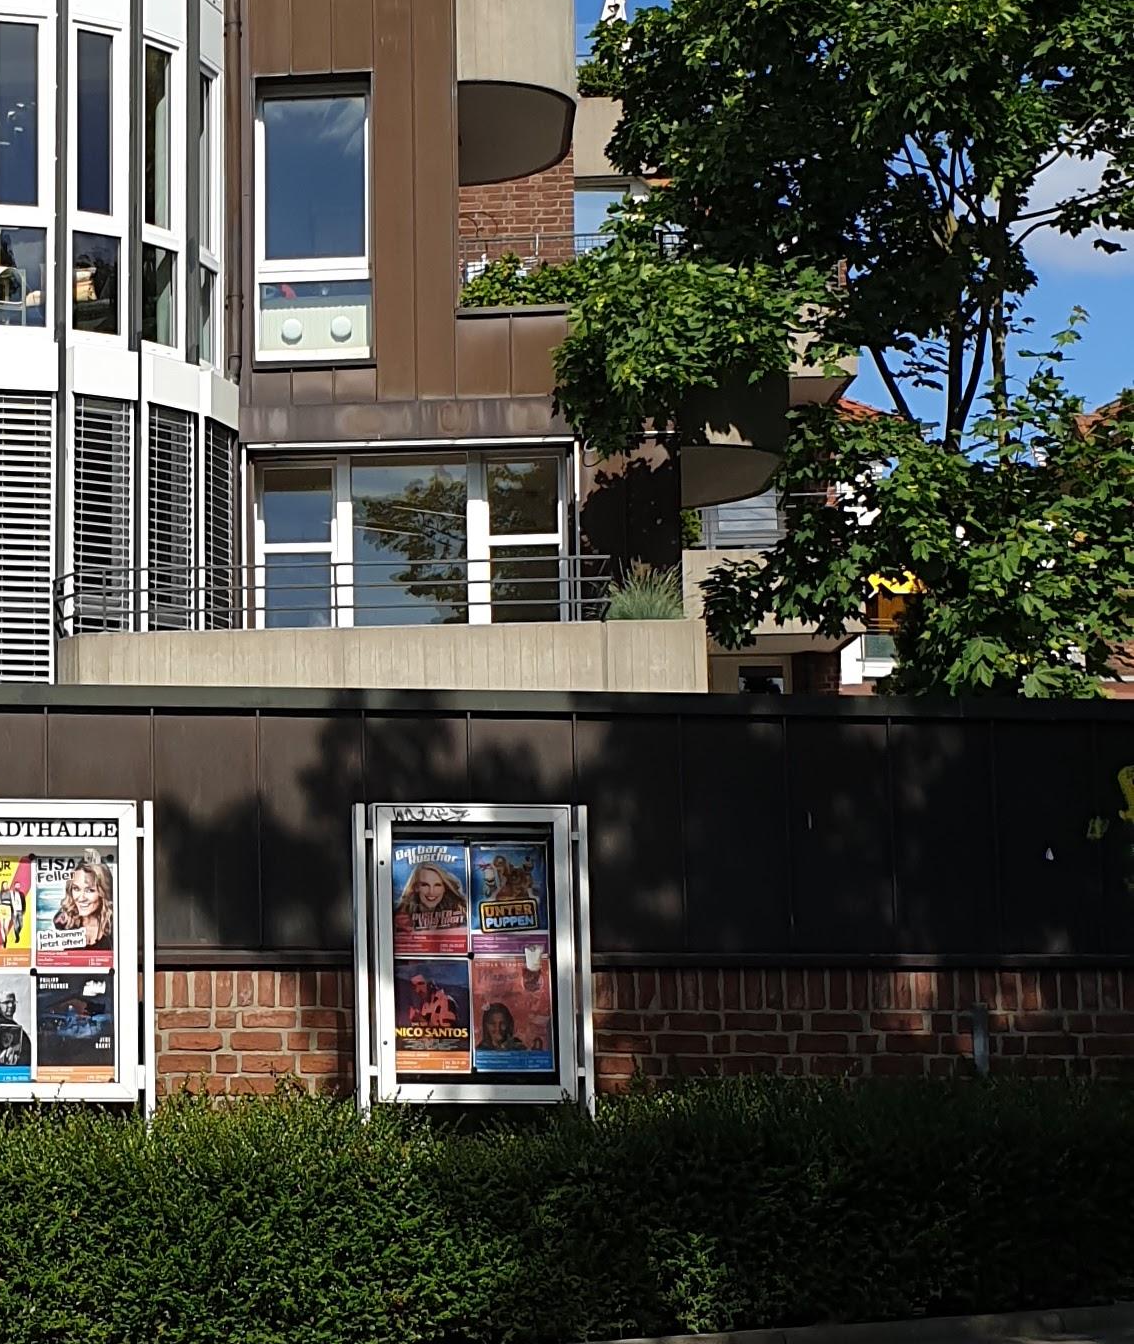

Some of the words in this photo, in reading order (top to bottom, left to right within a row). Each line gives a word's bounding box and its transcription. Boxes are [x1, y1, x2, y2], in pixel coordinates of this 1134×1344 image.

[37, 859, 76, 871] LISA
[37, 871, 75, 882] Feller
[485, 905, 533, 917] UNTER
[486, 916, 534, 928] PUPPEN
[394, 1027, 422, 1038] NICO
[424, 1027, 468, 1038] SANTOS
